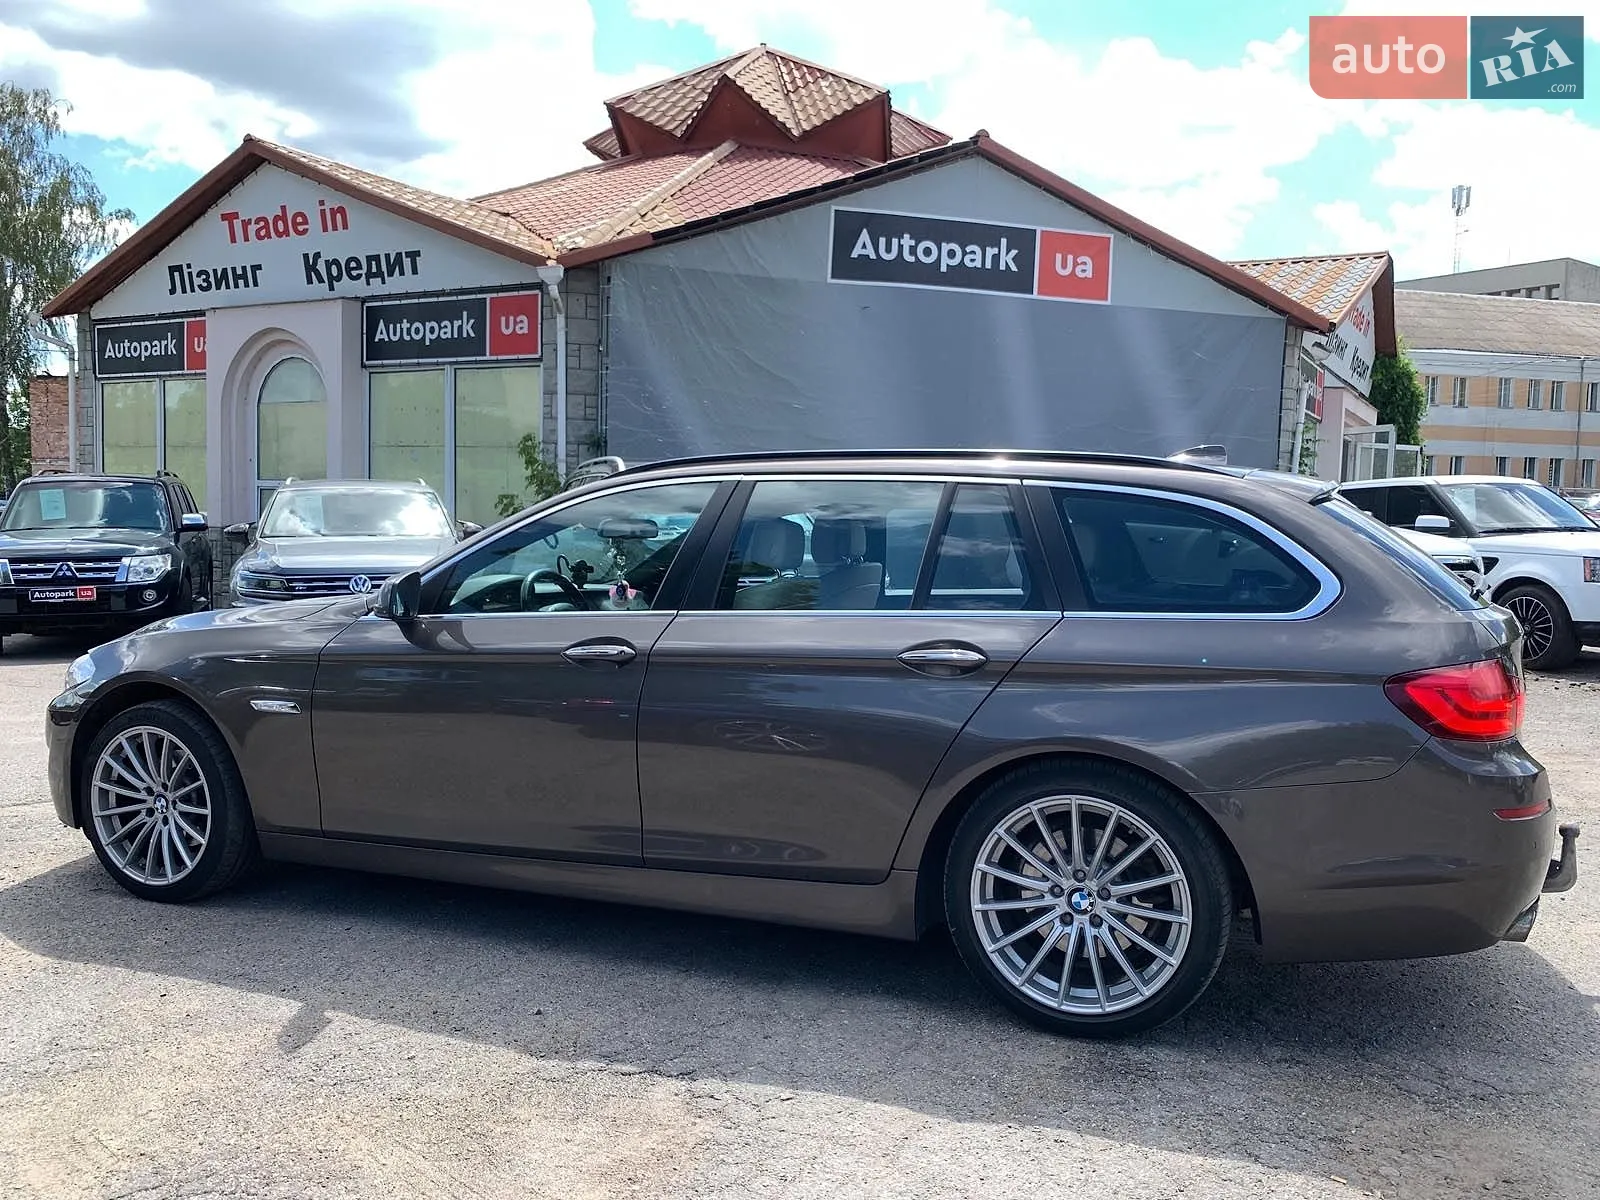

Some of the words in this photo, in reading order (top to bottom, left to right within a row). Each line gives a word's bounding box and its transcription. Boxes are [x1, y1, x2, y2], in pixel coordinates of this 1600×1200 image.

[221, 205, 309, 244] Trade
[318, 200, 349, 233] in
[850, 227, 1019, 273] Autopark
[1055, 252, 1094, 279] ua
[168, 263, 263, 296] Лізинг
[302, 250, 422, 292] Кредит
[104, 332, 177, 361] Autopark
[194, 336, 207, 353] u
[374, 311, 476, 346] Autopark
[500, 314, 529, 335] ua
[33, 590, 75, 599] Autopark
